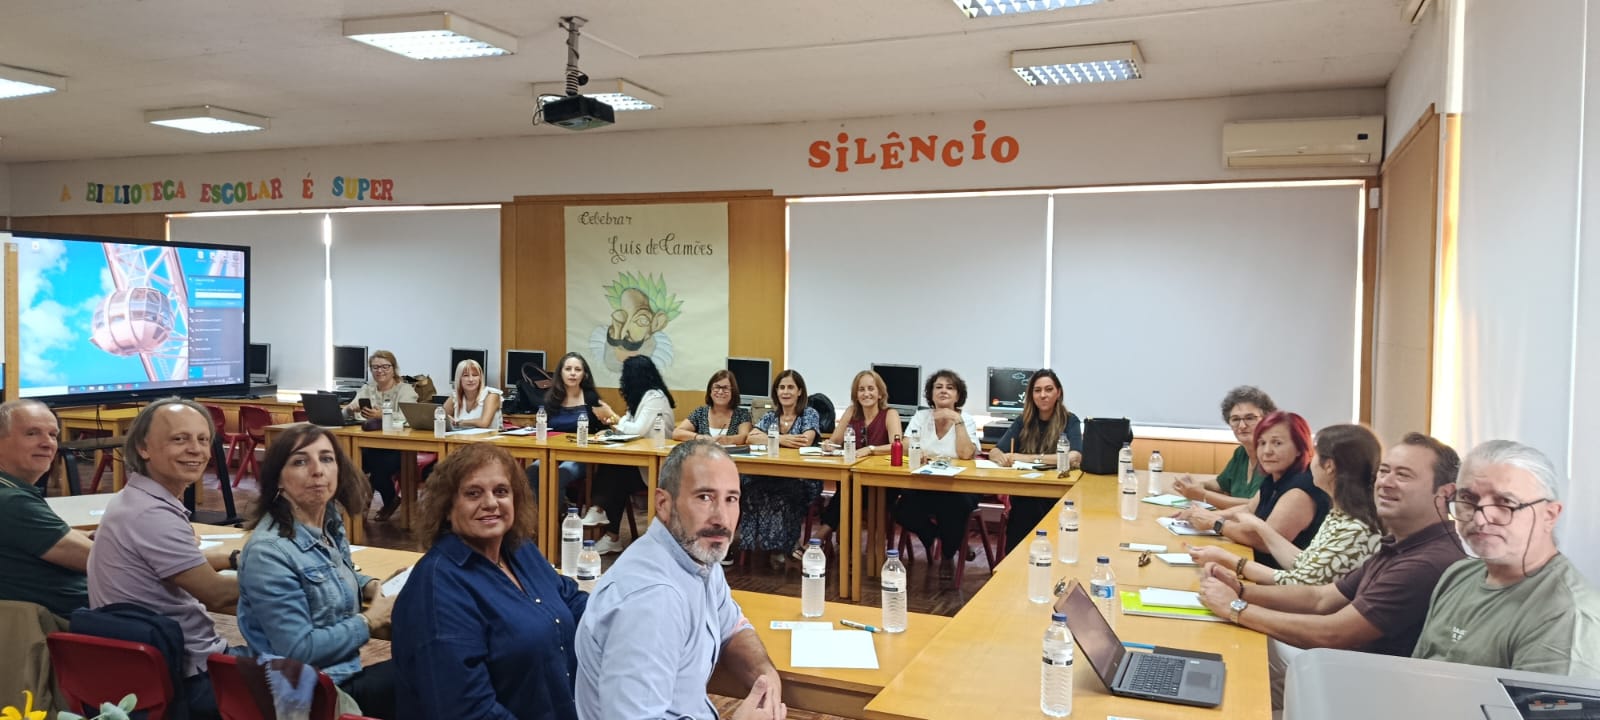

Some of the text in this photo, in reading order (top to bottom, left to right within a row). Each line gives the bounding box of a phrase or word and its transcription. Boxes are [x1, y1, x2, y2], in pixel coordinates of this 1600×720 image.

[60, 173, 394, 205] A BIBLIOTECA ESCOLAR É SUPER
[645, 238, 659, 255] de
[658, 233, 713, 256] Camões
